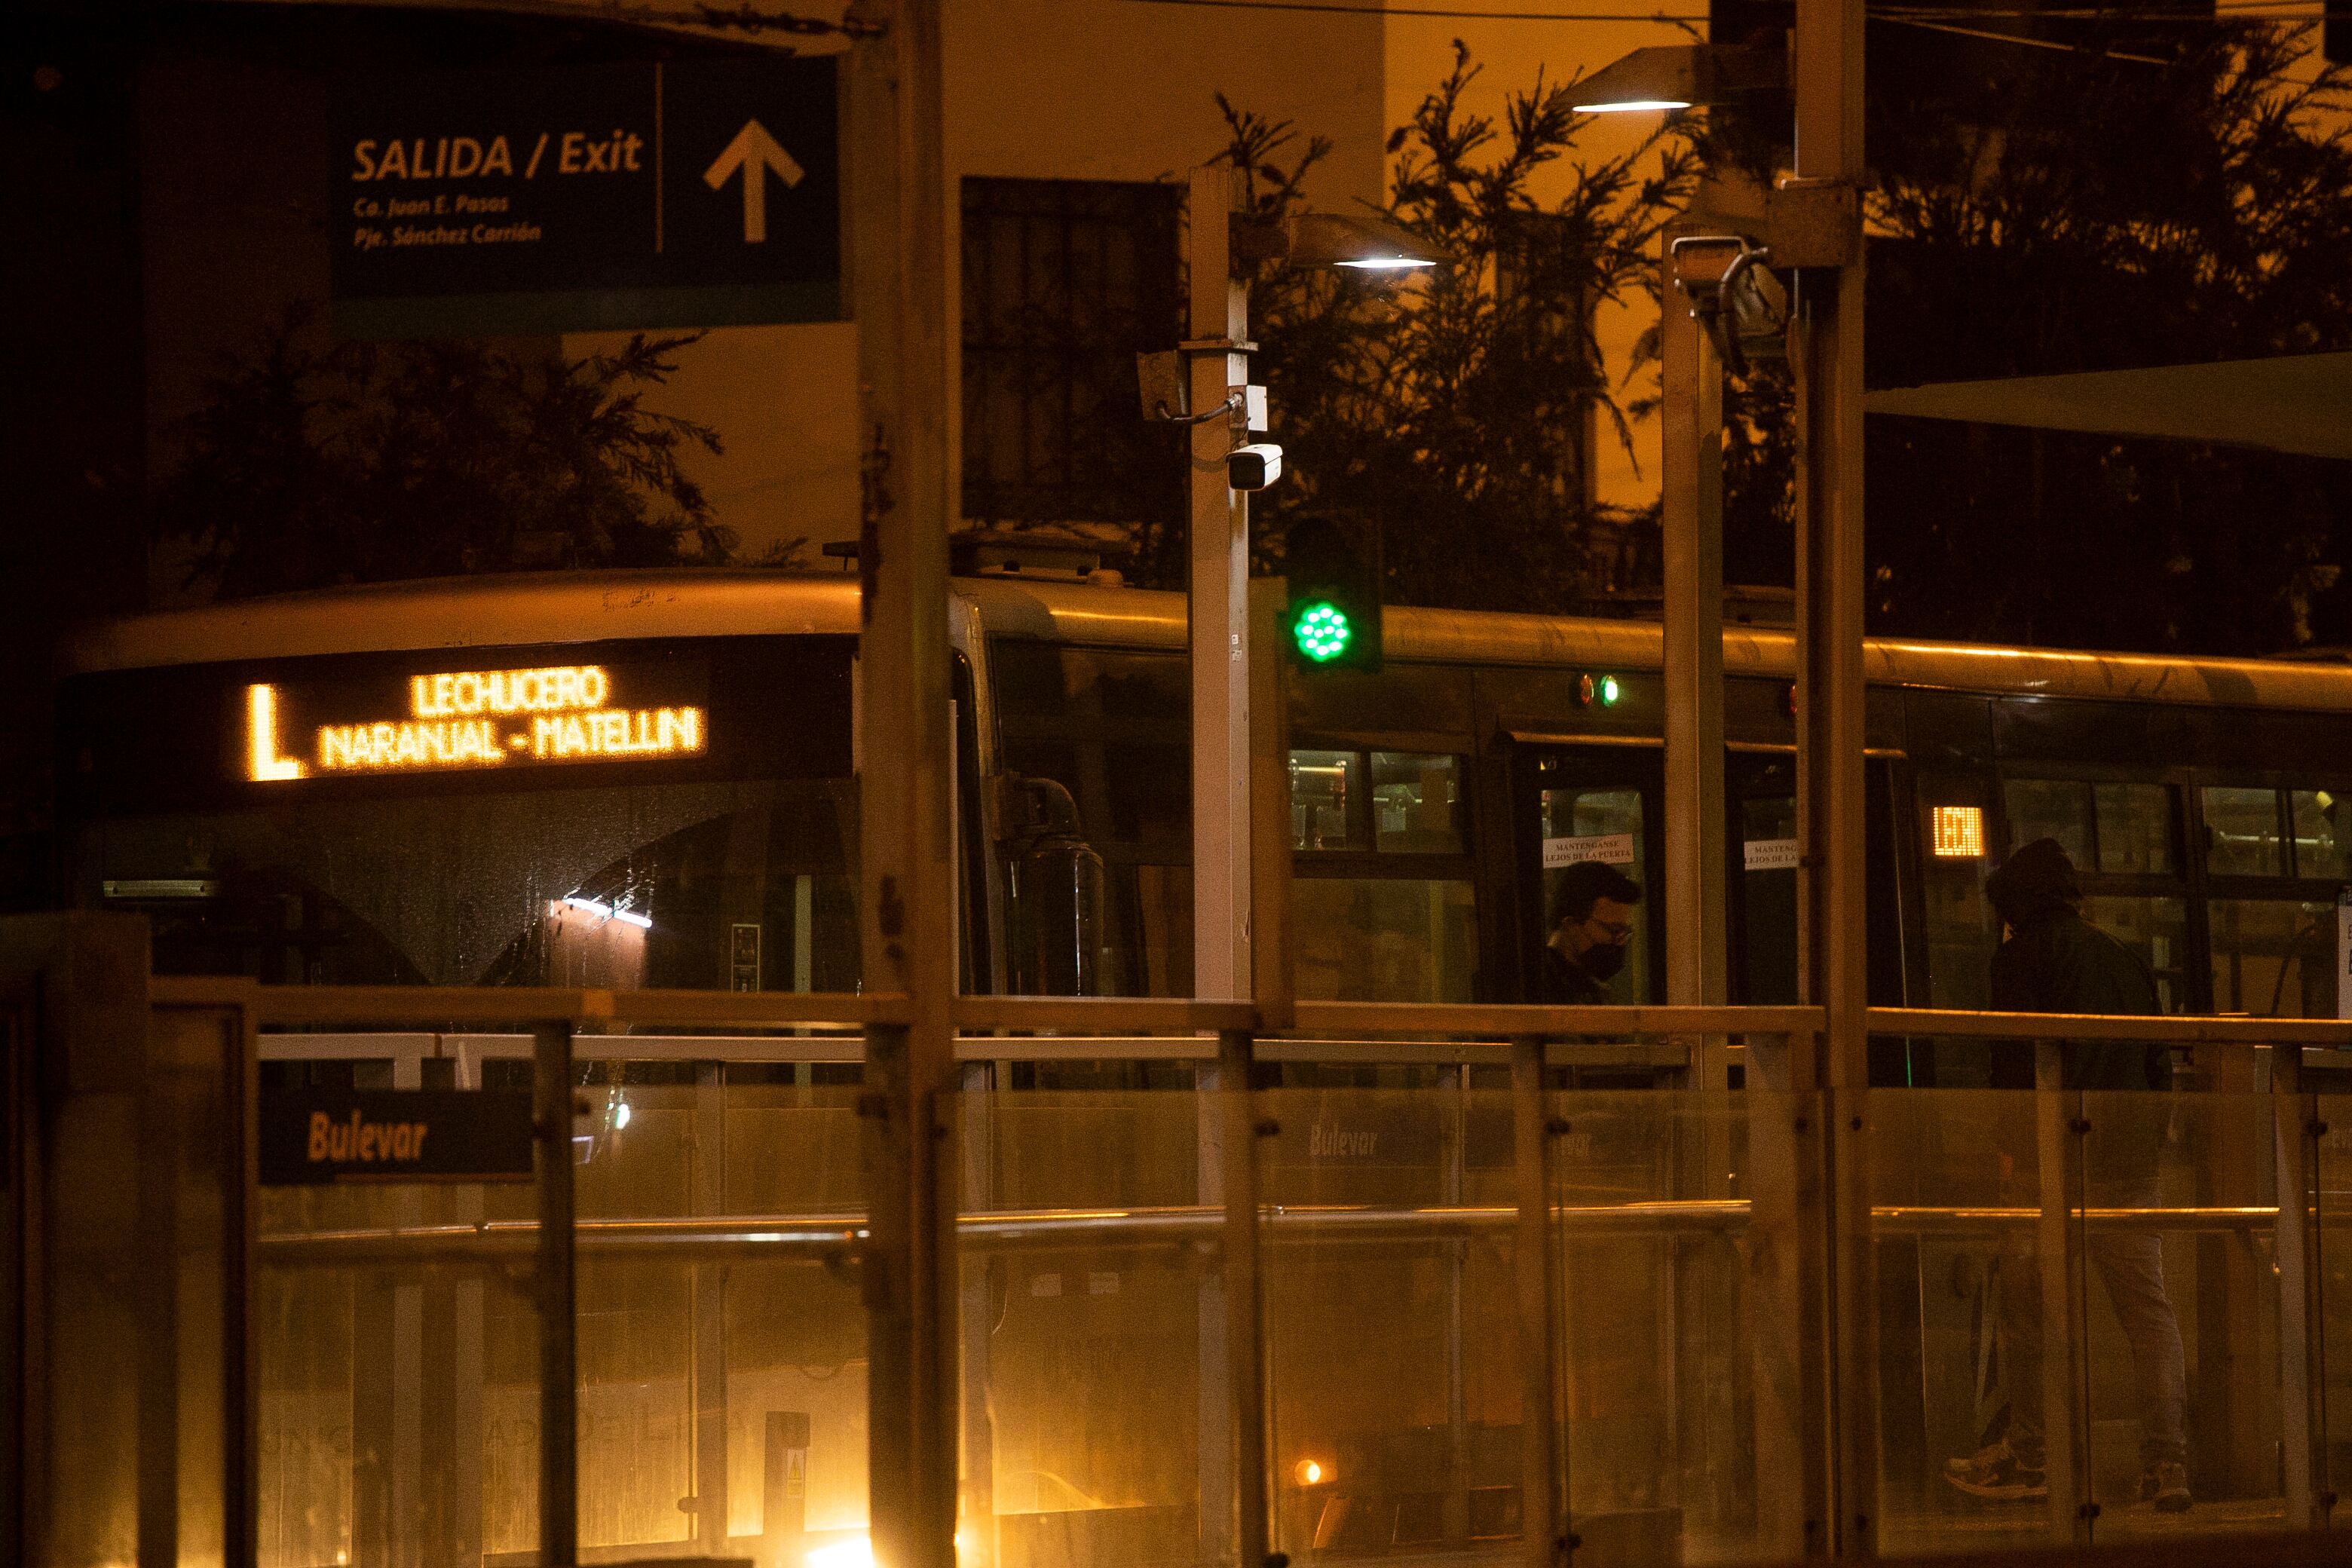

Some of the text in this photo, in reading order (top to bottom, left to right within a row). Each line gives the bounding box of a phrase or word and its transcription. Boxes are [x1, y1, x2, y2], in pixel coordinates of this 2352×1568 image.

[351, 128, 646, 182] SALIDA / Exit
[352, 197, 384, 218] Ca.
[386, 197, 431, 220] Juan
[433, 194, 452, 216] E.
[352, 221, 543, 251] Pje. Sánchez Carrión
[415, 666, 607, 717] LECHUCERO
[248, 684, 304, 780] L
[320, 721, 506, 767] NARANJAL
[1573, 853, 1583, 861] DE
[1754, 845, 1797, 853] MANTENG
[306, 1107, 428, 1162] Bulevar
[1309, 1119, 1379, 1156] Bulevar
